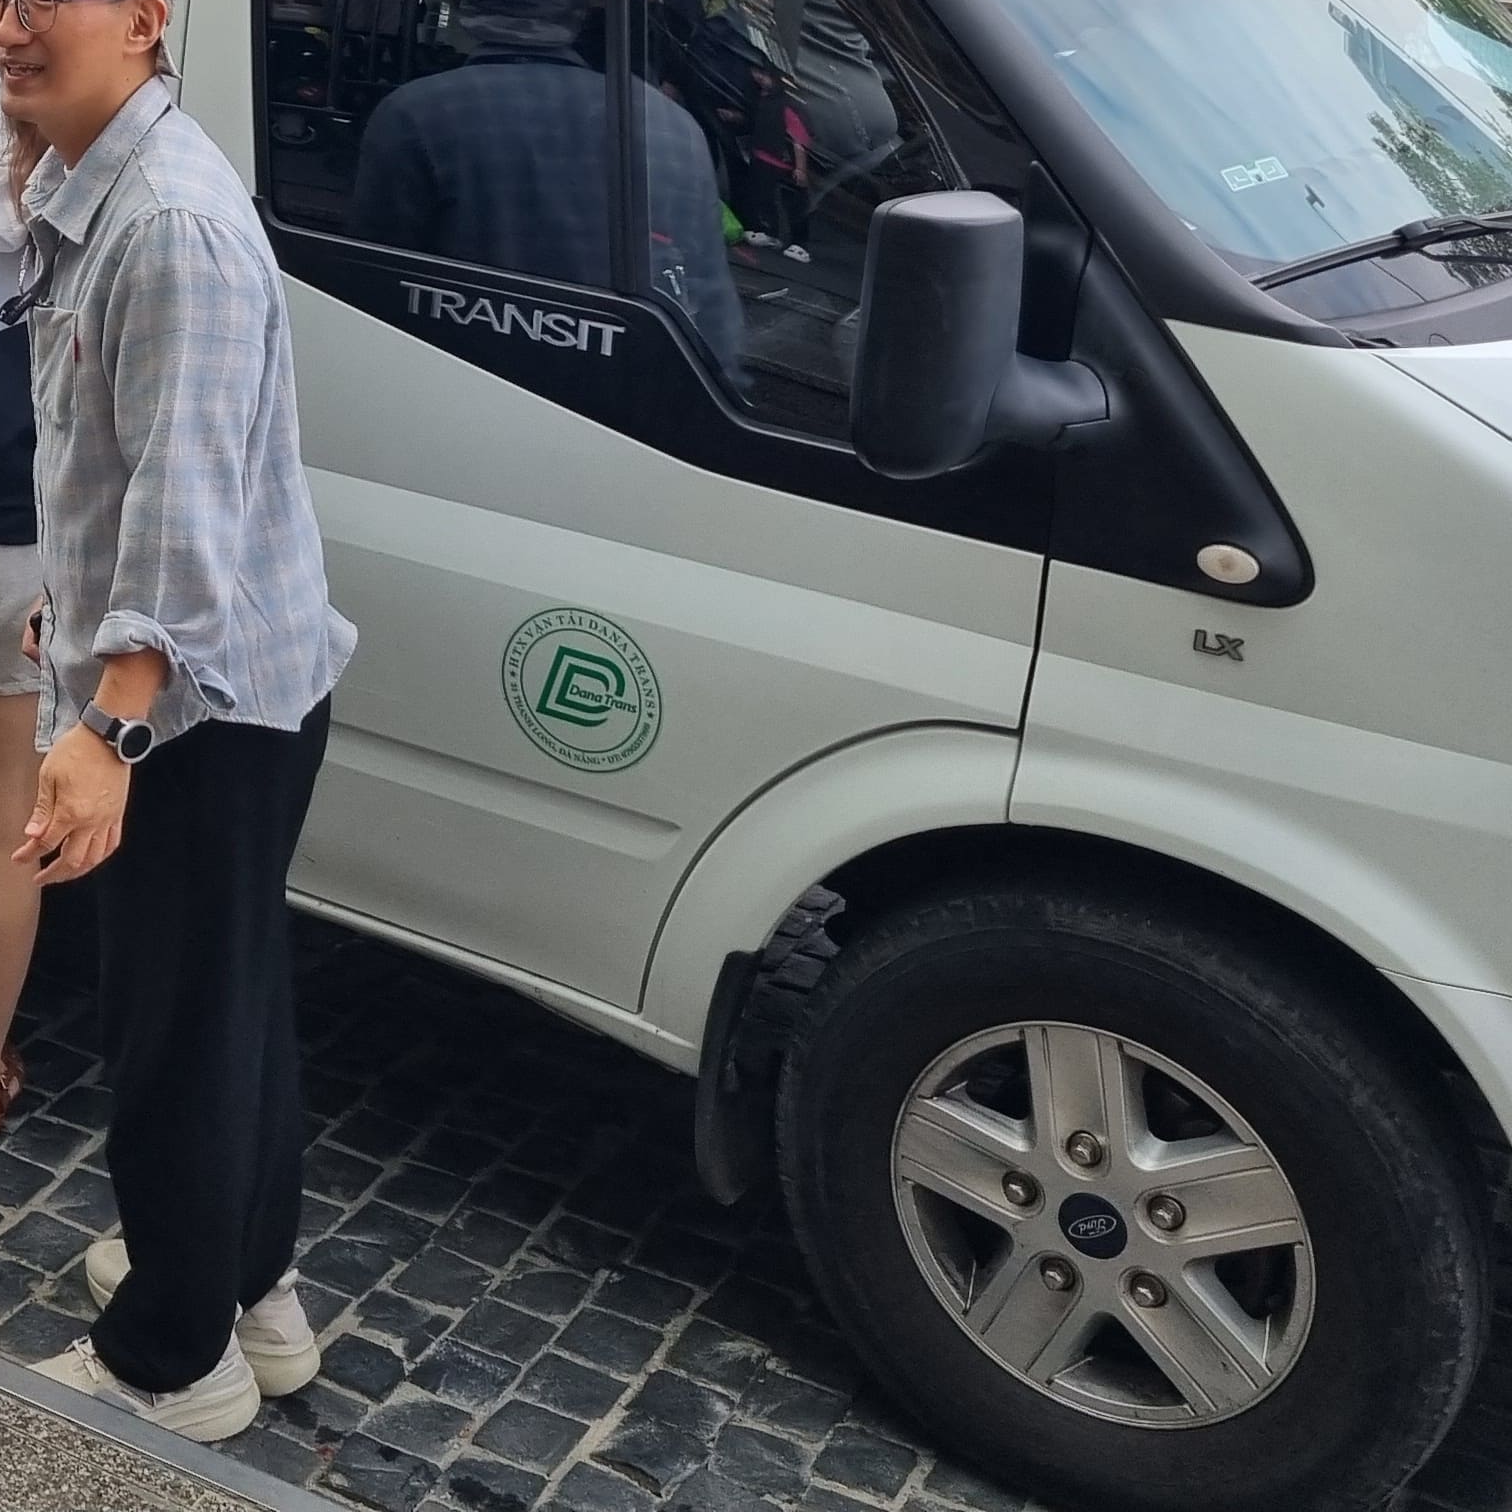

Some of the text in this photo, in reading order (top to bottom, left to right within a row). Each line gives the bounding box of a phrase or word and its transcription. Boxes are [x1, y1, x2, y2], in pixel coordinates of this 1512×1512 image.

[400, 280, 626, 357] TRANSIT
[508, 637, 528, 668] HTX
[589, 619, 628, 653] DANA
[629, 653, 656, 709] TRANS
[1193, 629, 1245, 662] LX
[569, 684, 637, 713] Dana Trans
